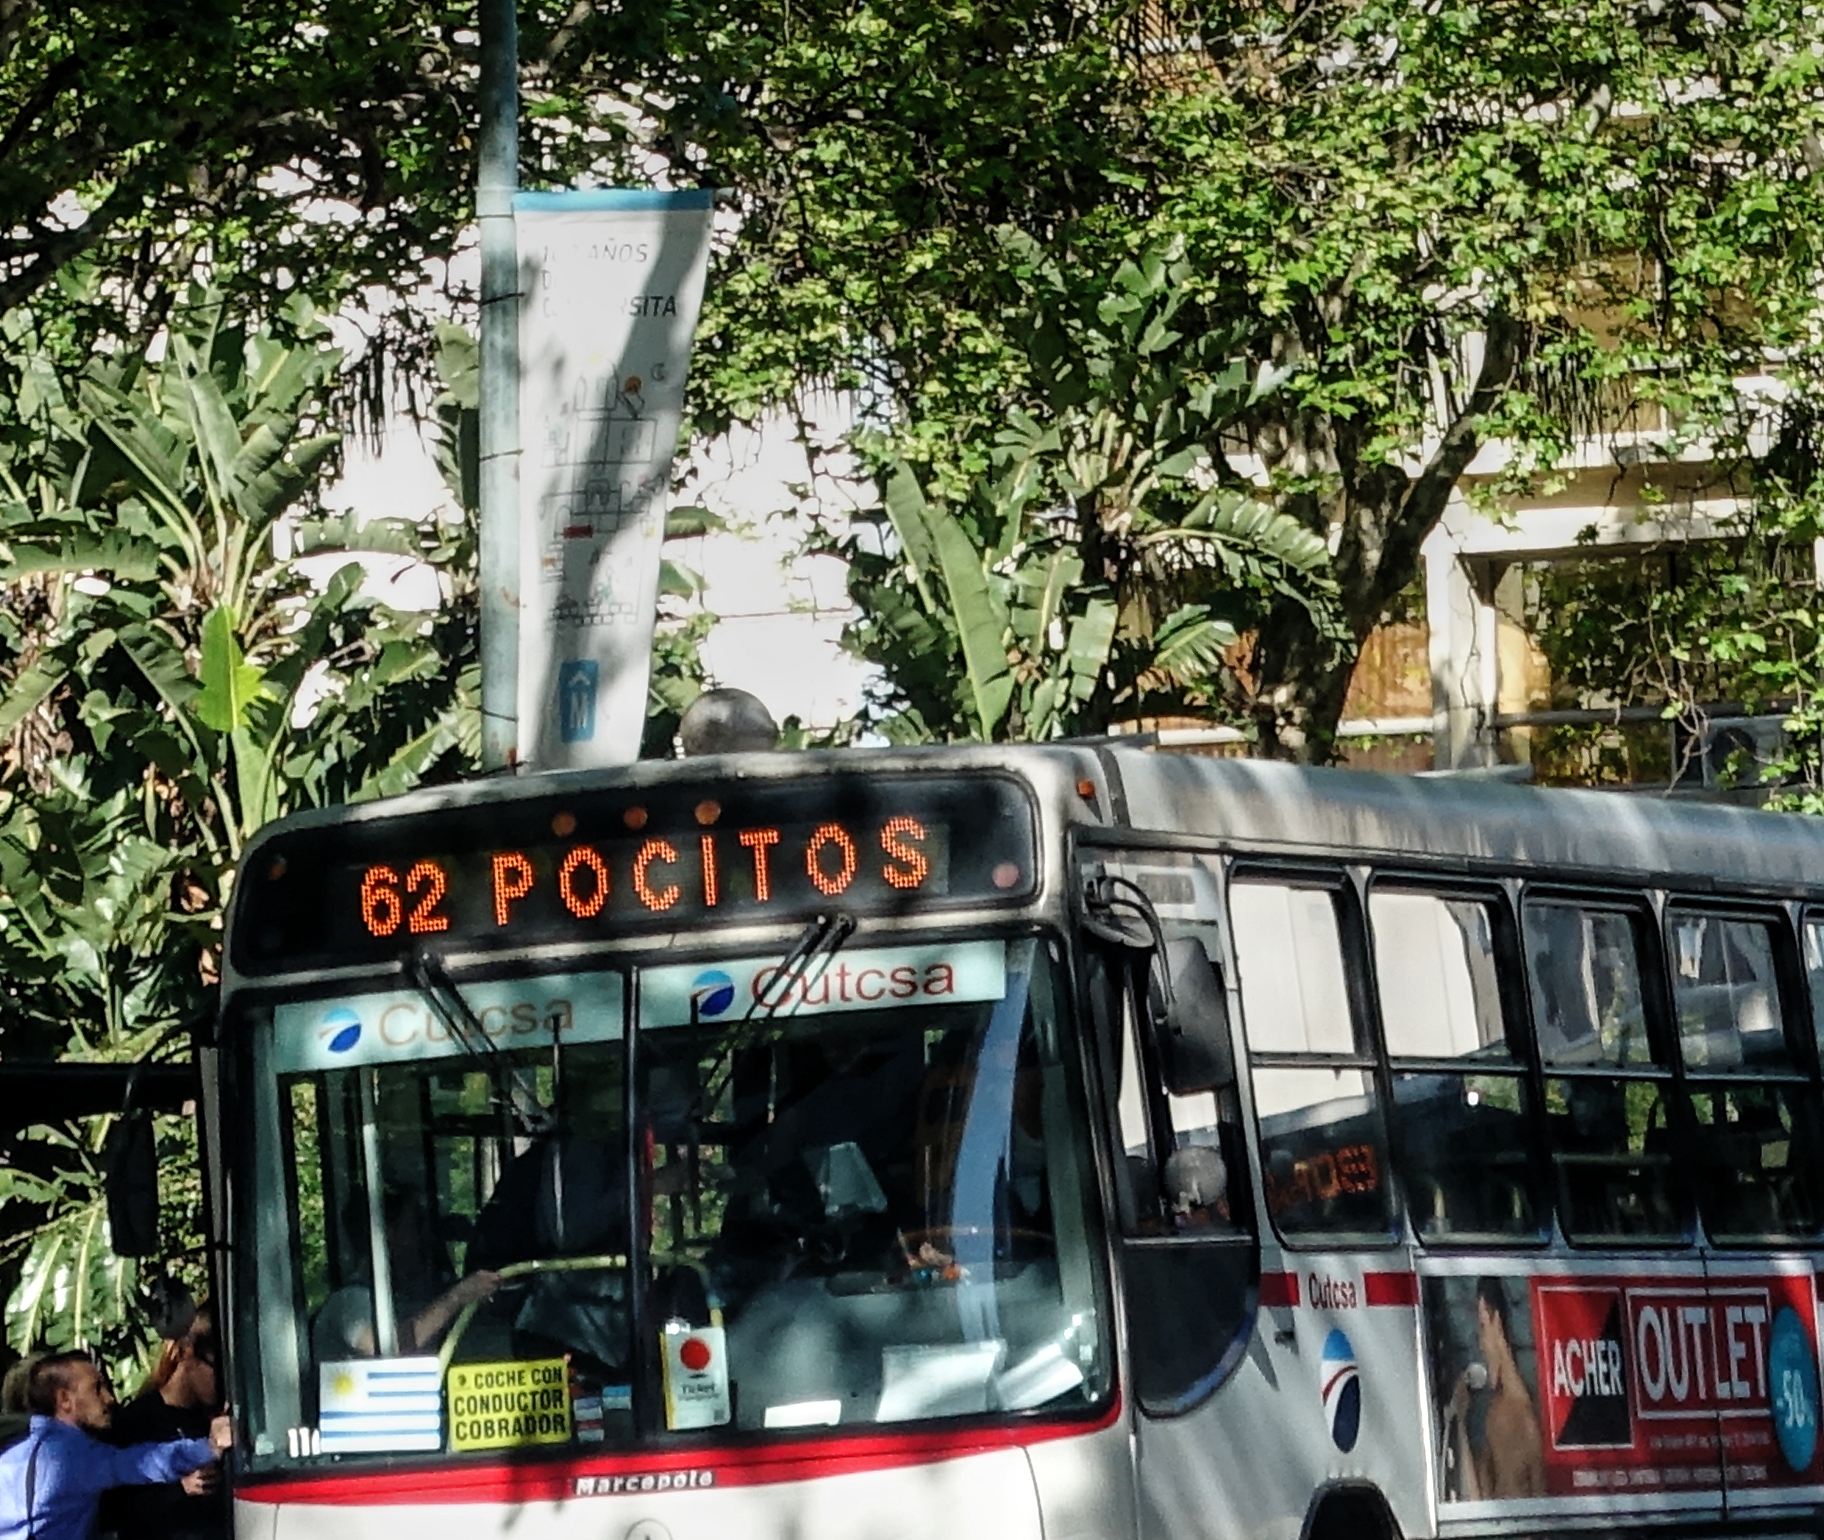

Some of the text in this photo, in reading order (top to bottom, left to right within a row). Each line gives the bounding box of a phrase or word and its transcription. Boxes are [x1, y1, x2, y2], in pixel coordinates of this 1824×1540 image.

[360, 816, 929, 937] 62 POCITOS
[751, 961, 955, 1009] Cutcsa
[379, 998, 574, 1047] Cucsa
[1554, 1339, 1625, 1397] ACHER
[1637, 1306, 1767, 1401] OUTLET
[454, 1388, 564, 1417] CONDUCTOR
[474, 1370, 526, 1389] COCHE
[455, 1413, 566, 1441] COBRADOR
[576, 1469, 713, 1496] Marcopolo
